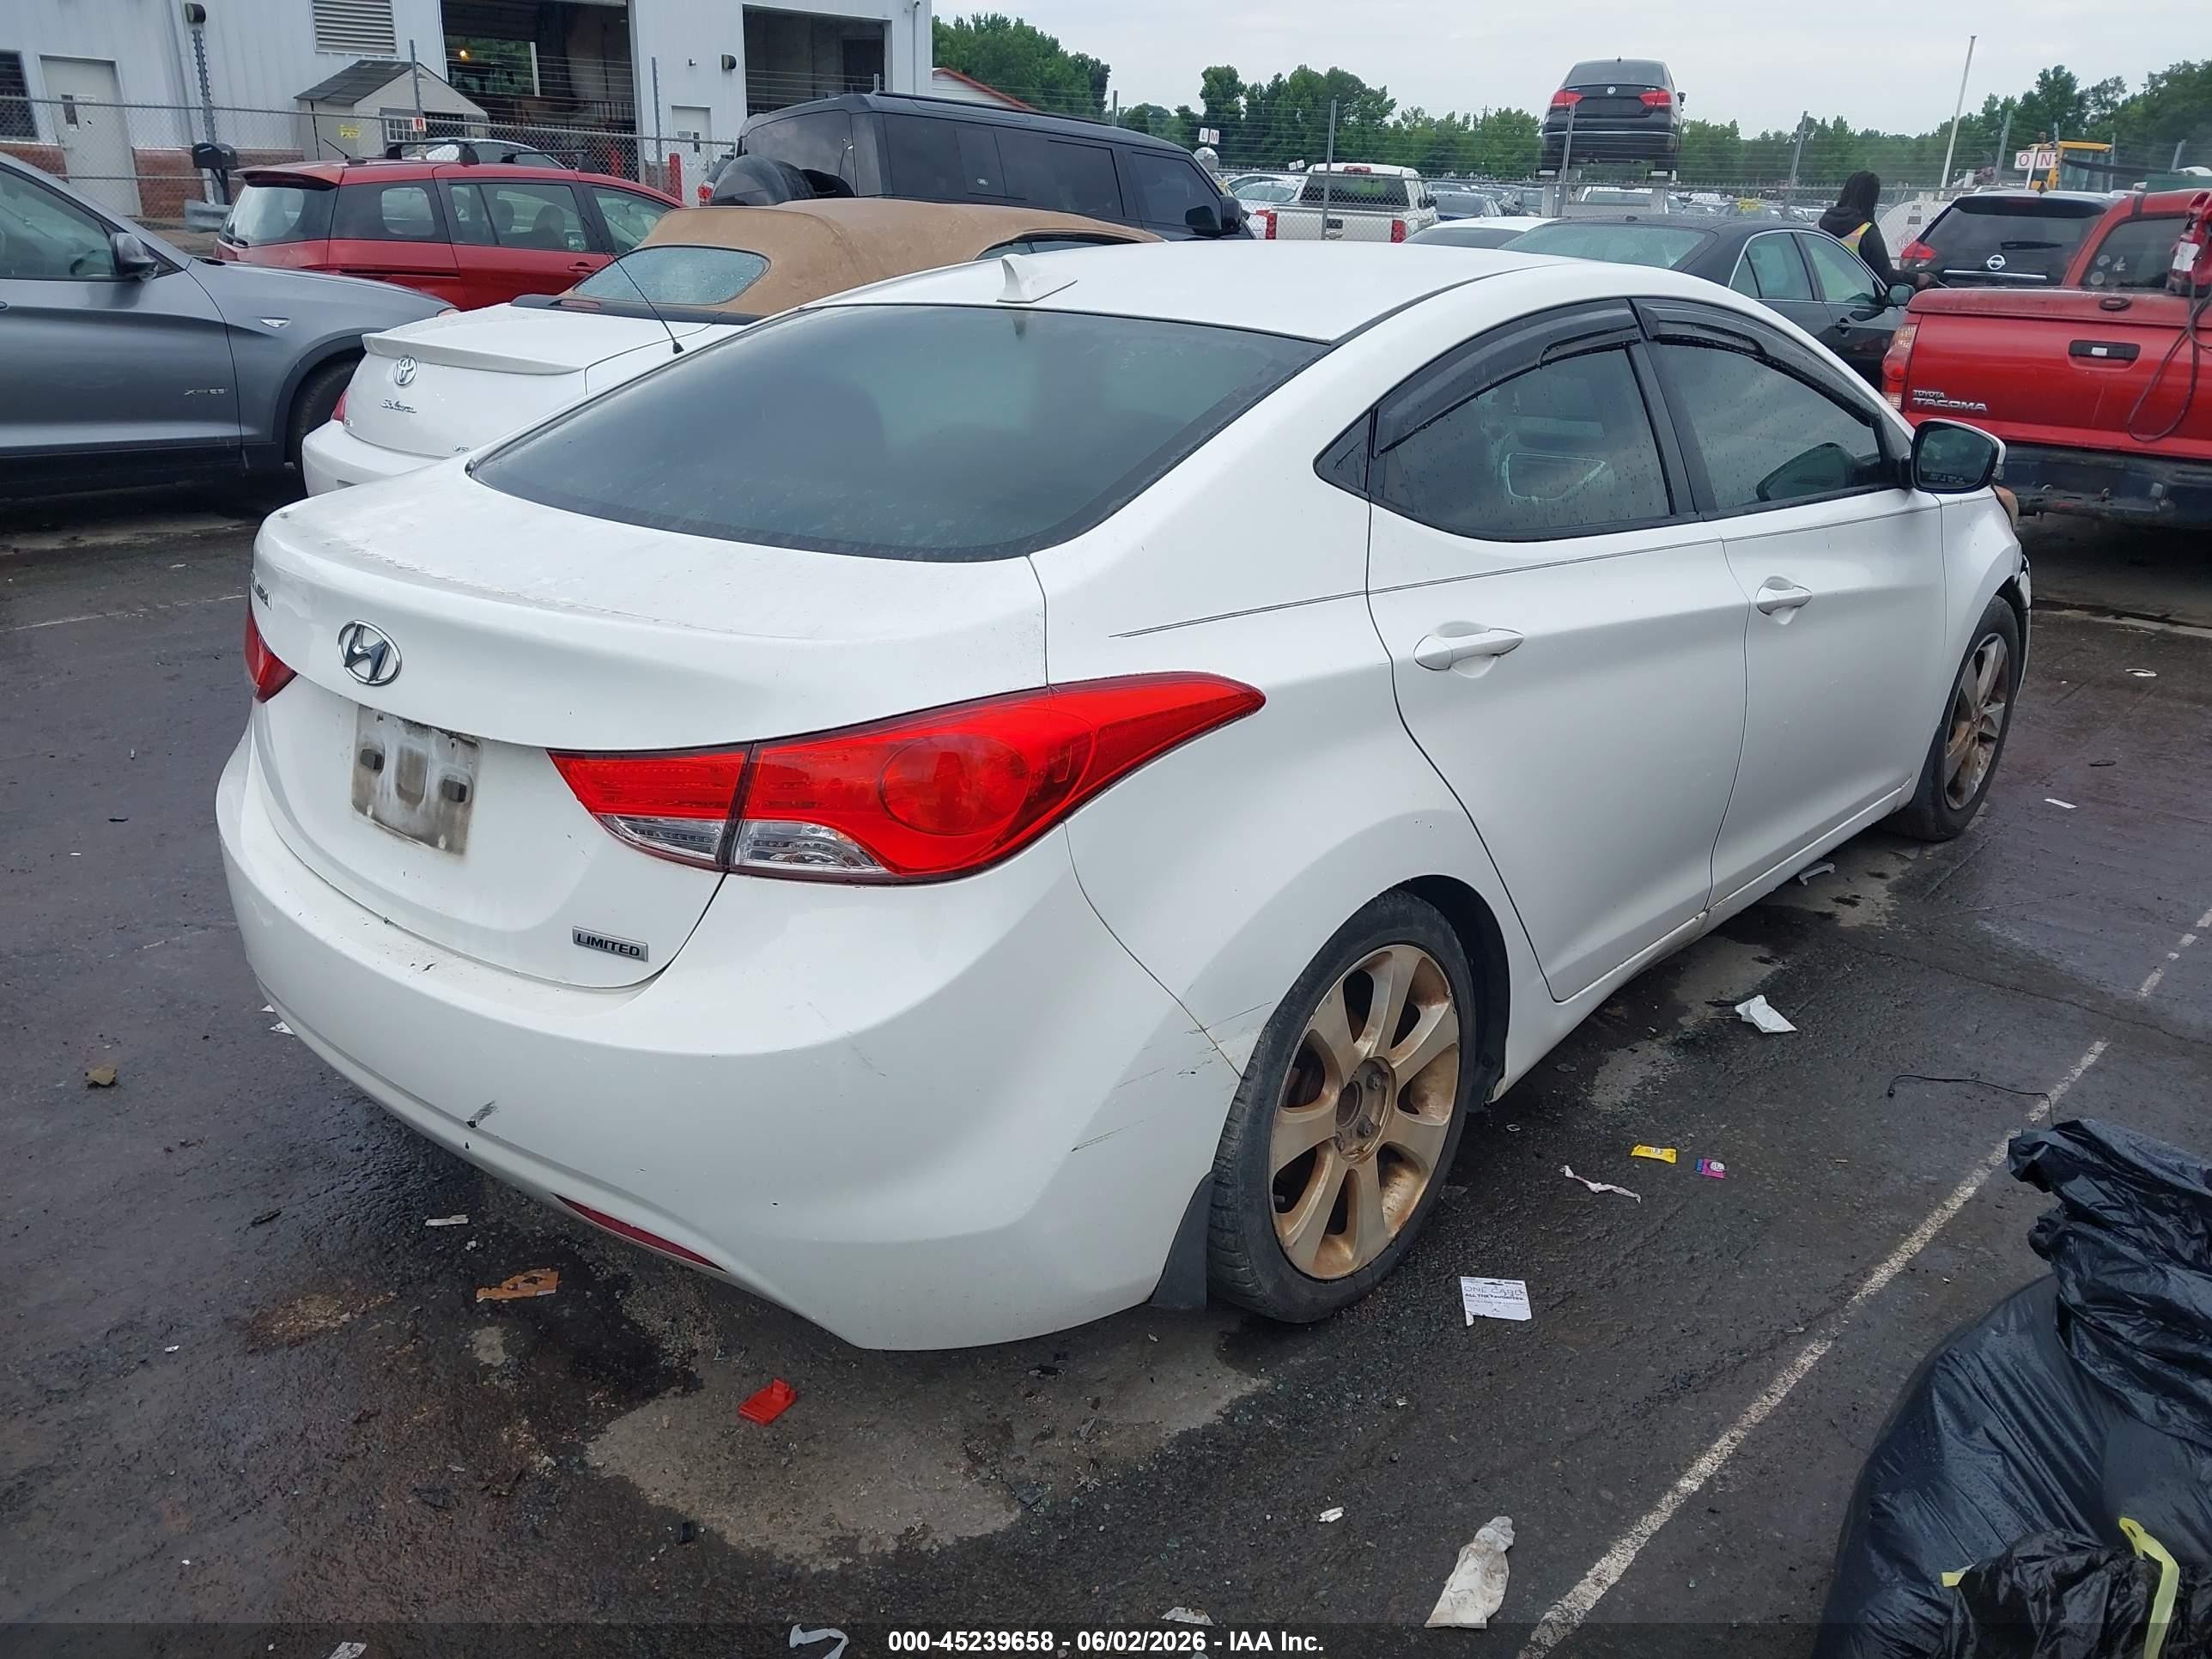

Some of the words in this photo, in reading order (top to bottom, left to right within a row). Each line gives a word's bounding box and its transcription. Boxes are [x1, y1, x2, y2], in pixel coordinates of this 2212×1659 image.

[2019, 154, 2030, 167] O
[2040, 154, 2052, 167] N
[1912, 389, 1945, 398] TOYOTA
[1912, 398, 1987, 411] TACOMA
[577, 933, 640, 957] LIMITED
